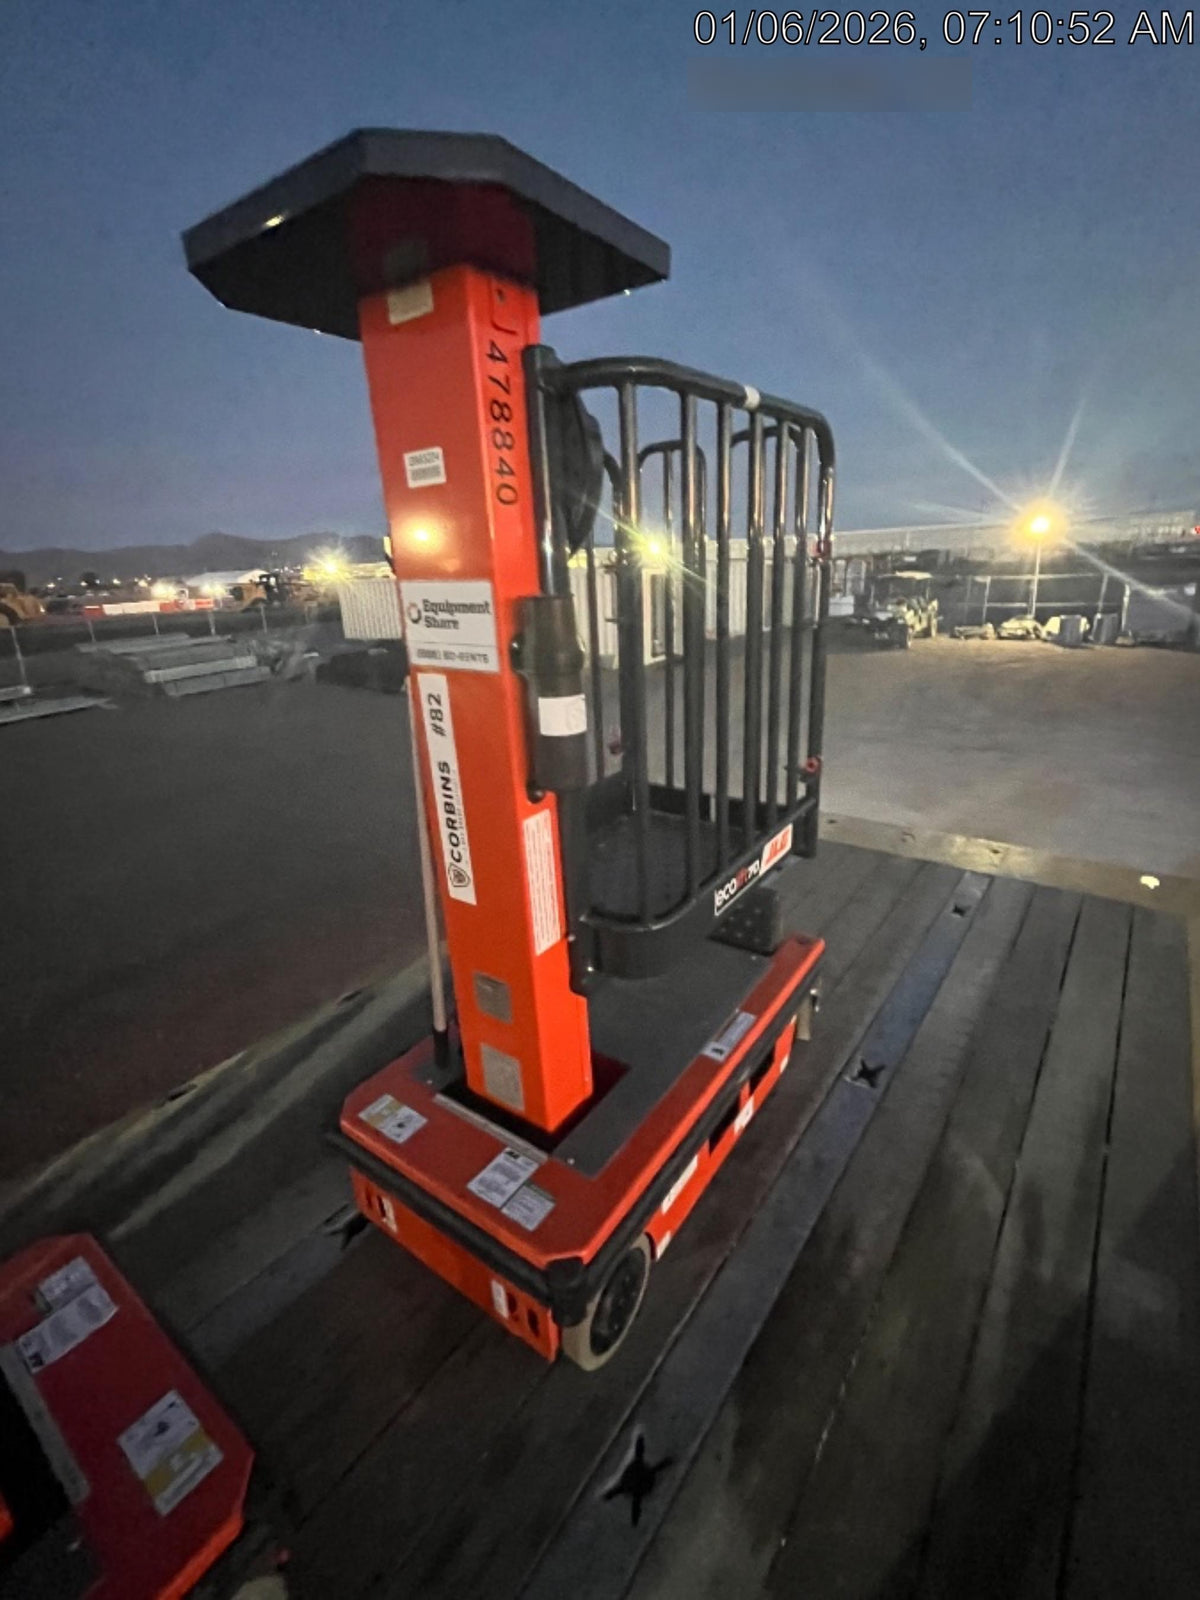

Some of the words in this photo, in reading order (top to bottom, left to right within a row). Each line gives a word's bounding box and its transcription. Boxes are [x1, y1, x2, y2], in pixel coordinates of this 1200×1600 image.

[422, 598, 491, 617] Equipment
[424, 616, 460, 630] Share
[427, 692, 446, 737] #82
[438, 760, 462, 864] CORBINS
